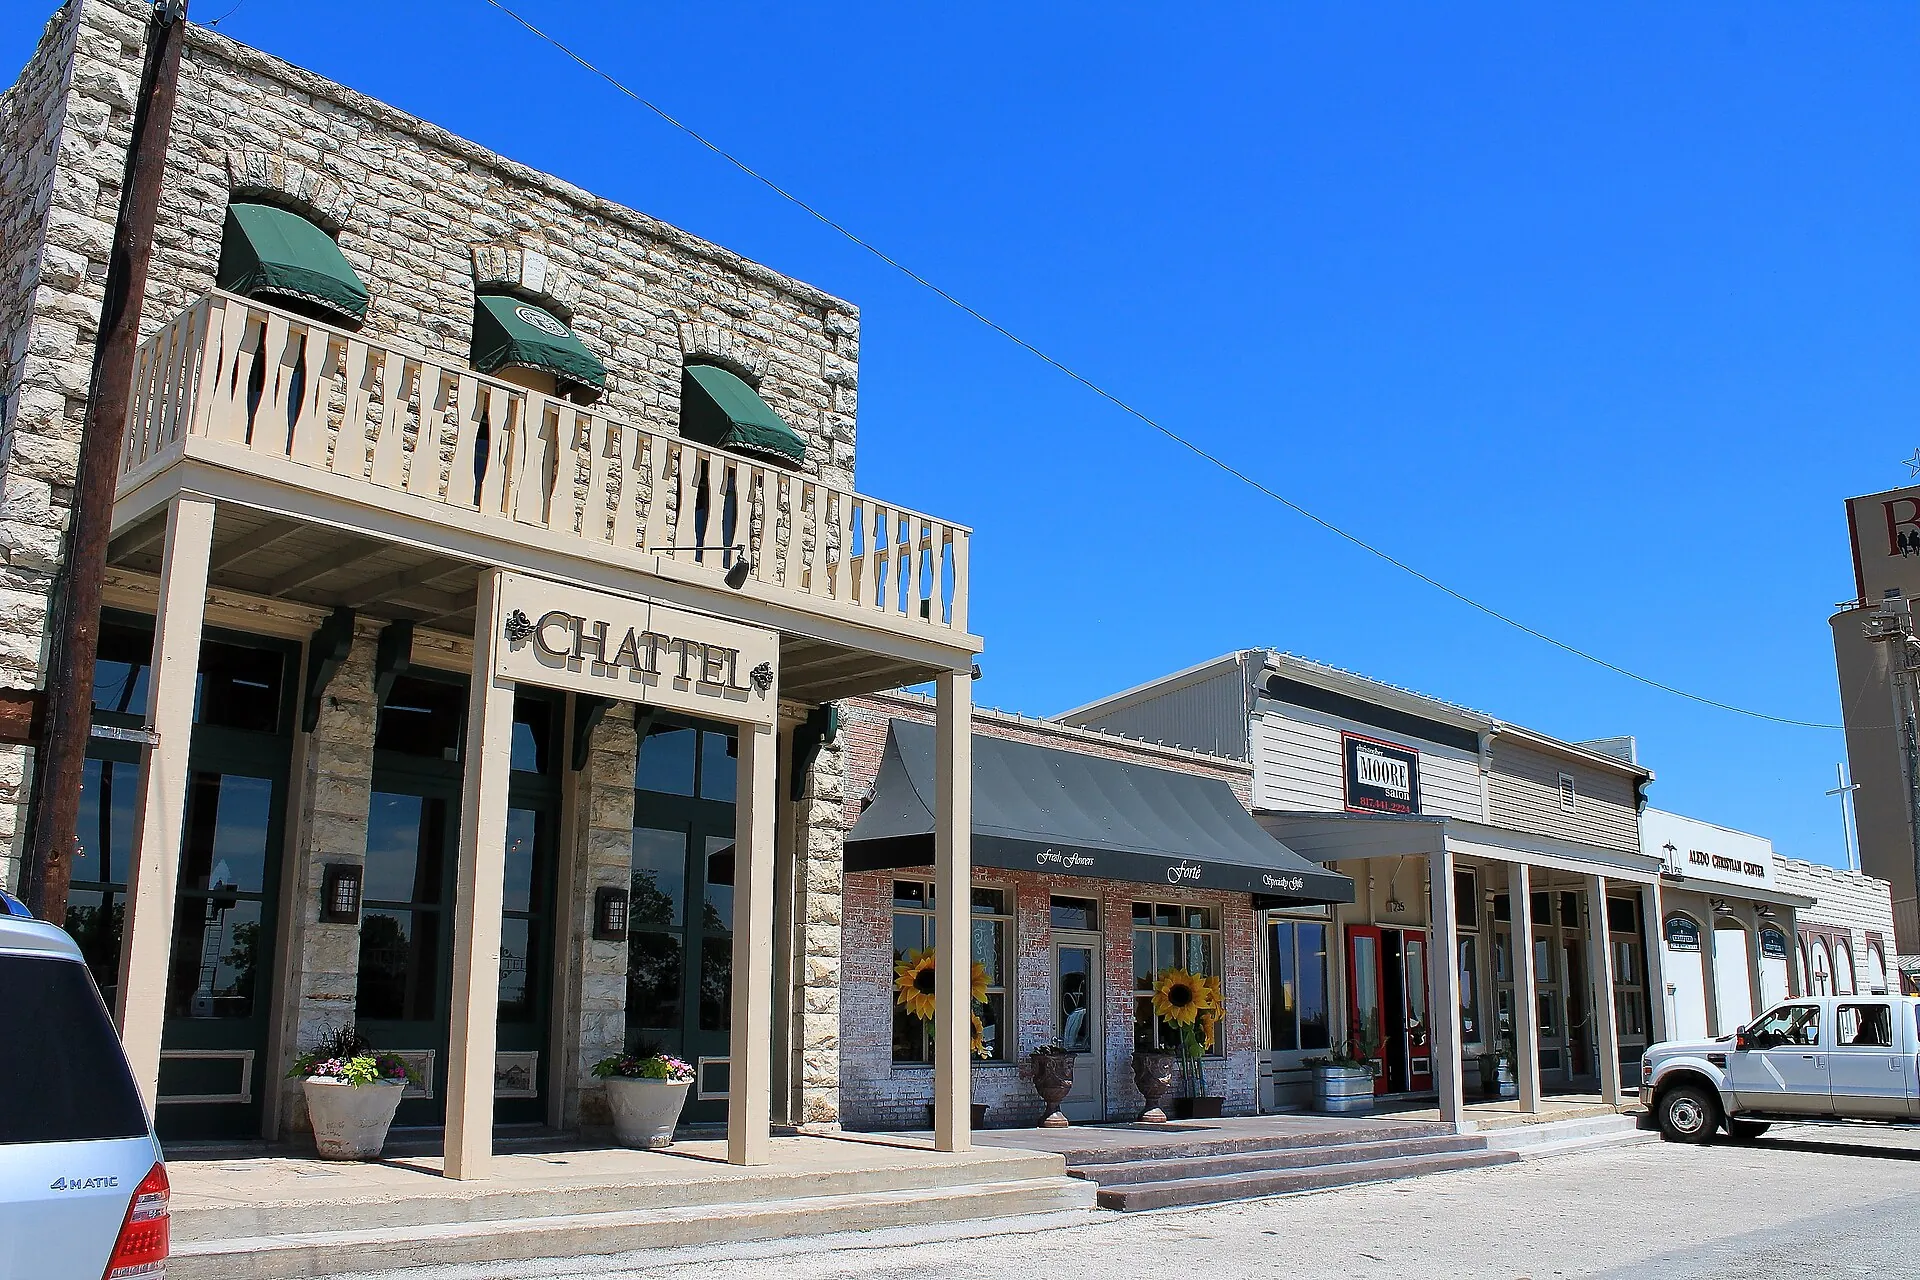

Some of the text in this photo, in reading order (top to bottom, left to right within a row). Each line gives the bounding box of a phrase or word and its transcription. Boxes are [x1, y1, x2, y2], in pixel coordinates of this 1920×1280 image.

[535, 610, 752, 693] CHATTEL
[1359, 755, 1407, 788] MOORE
[1360, 796, 1410, 813] 817.441.2224
[1385, 788, 1411, 801] salon
[1036, 849, 1095, 869] Fresh Flowers
[1689, 849, 1765, 878] ALEDO CHRISTIAN CENTER
[1167, 859, 1202, 884] Forté
[1262, 874, 1304, 891] Specialty Gifts
